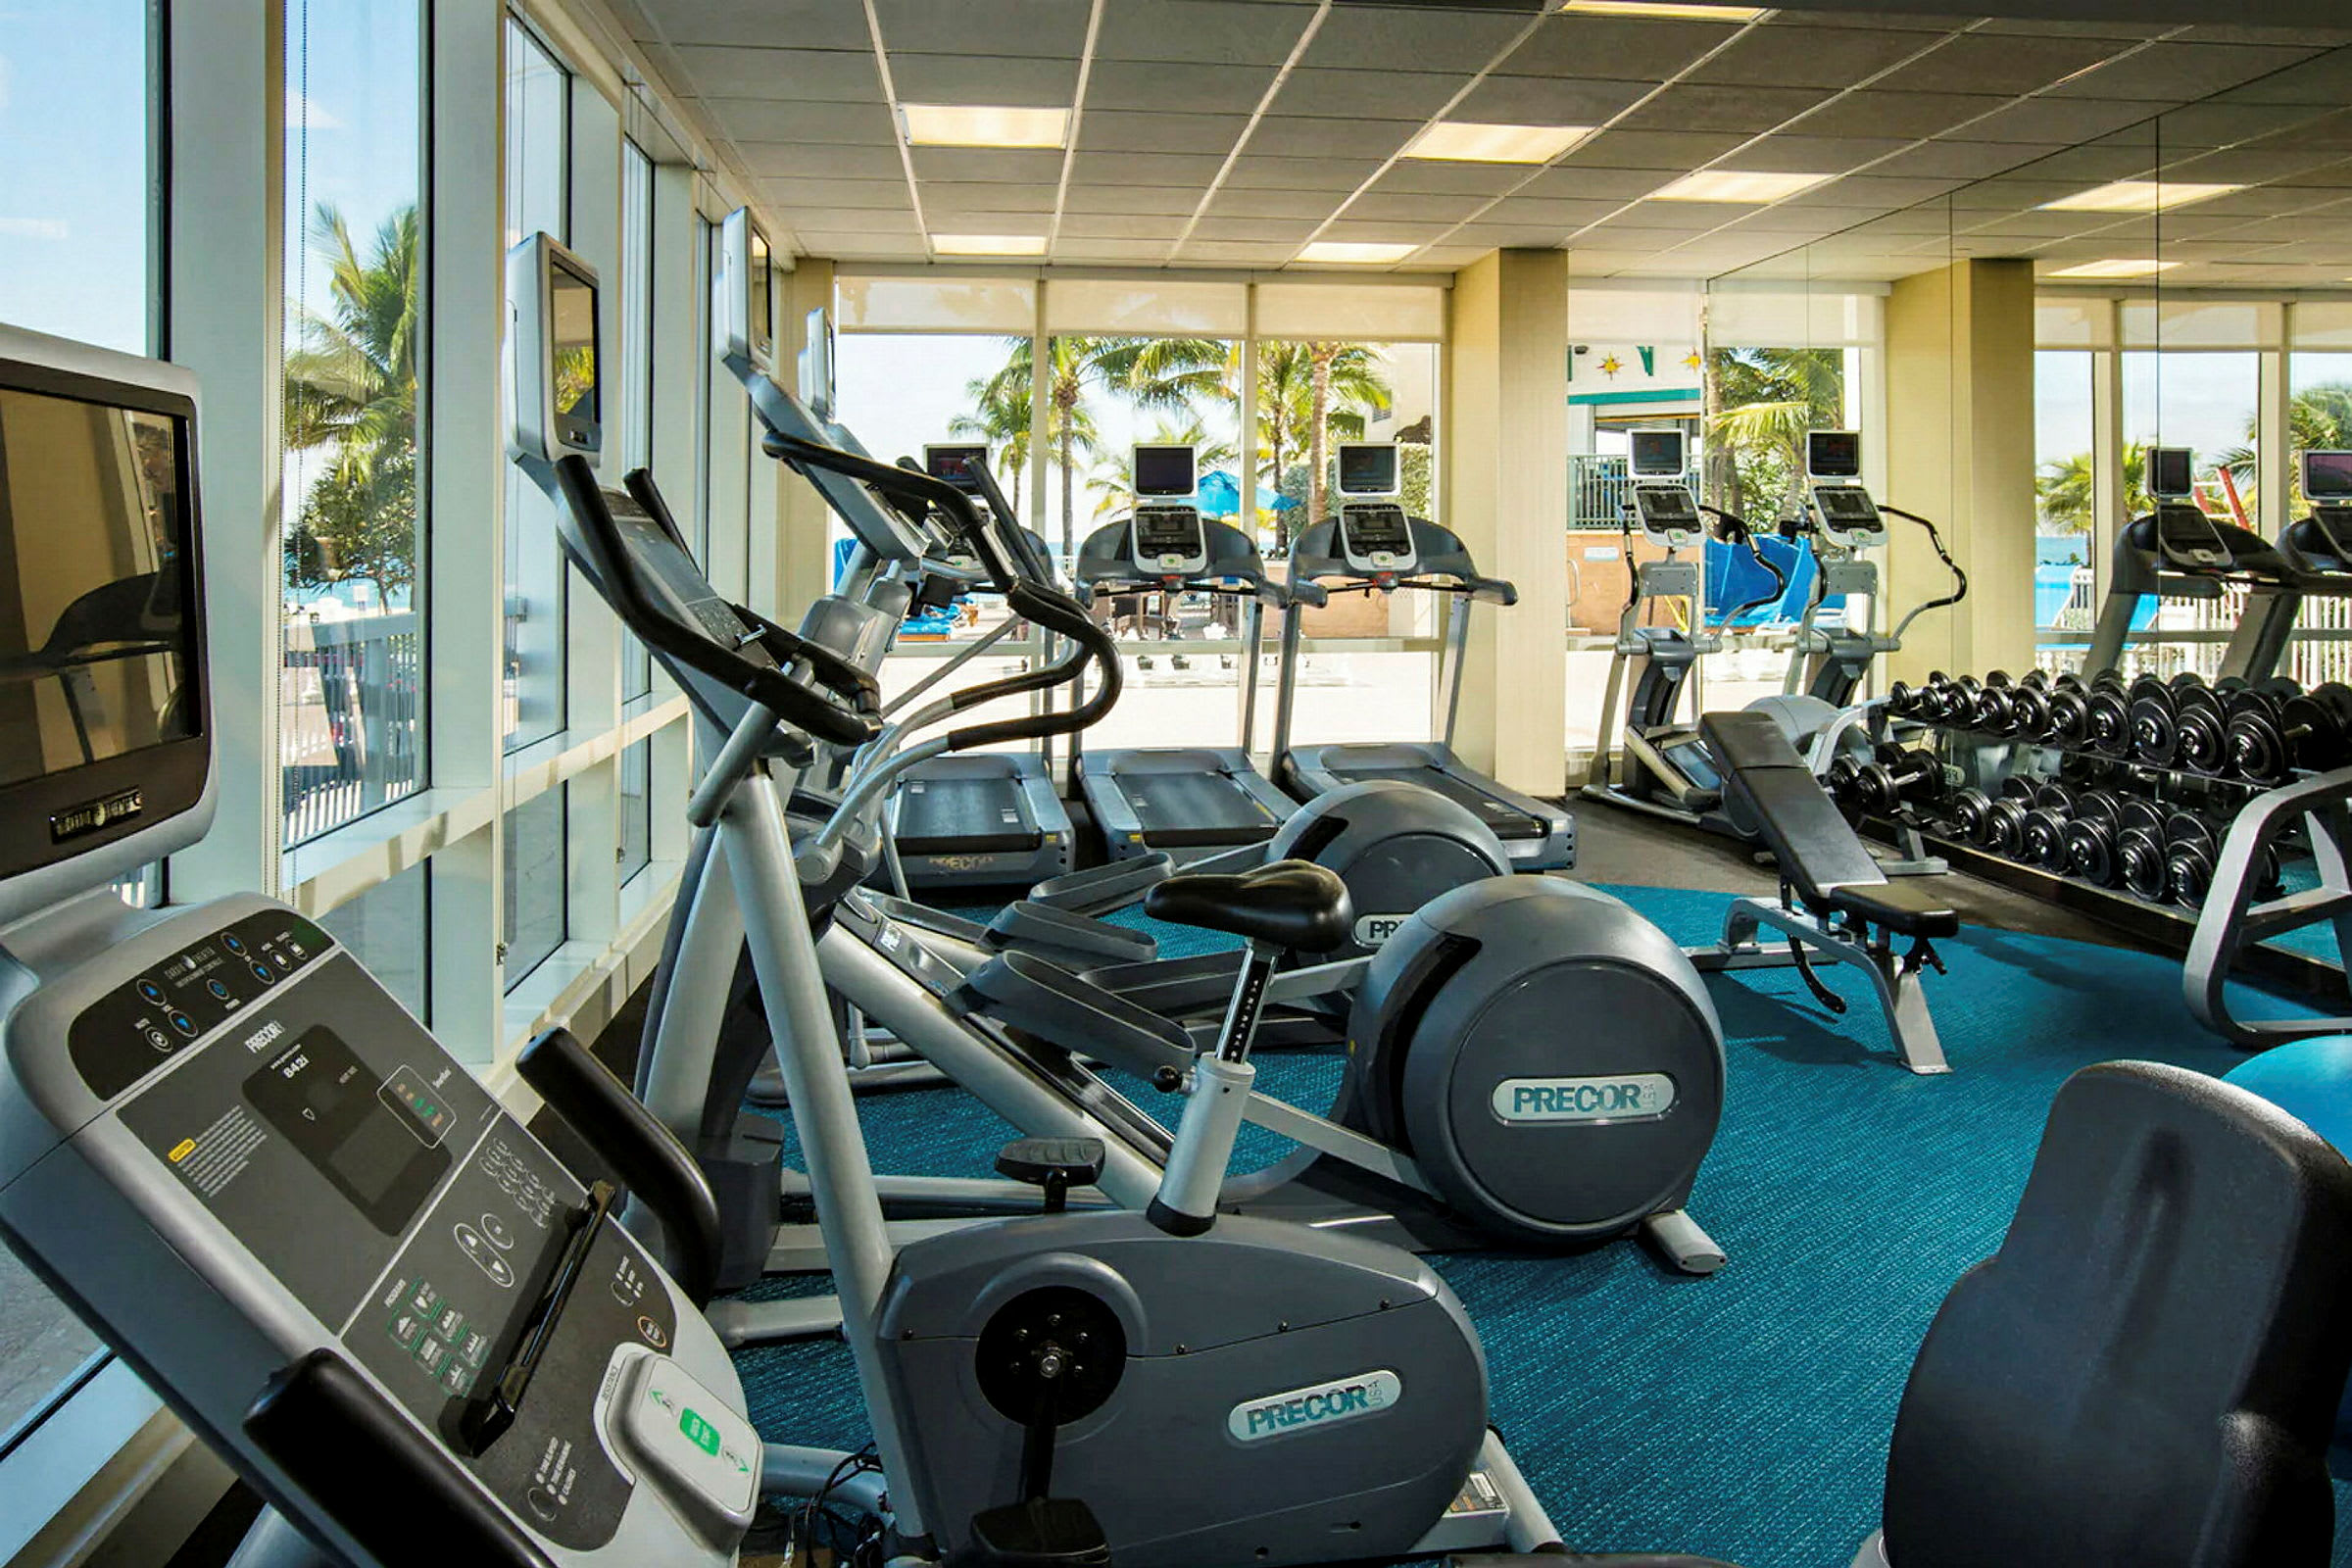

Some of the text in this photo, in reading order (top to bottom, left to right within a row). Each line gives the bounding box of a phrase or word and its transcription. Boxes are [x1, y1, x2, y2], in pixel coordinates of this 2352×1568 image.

[1514, 1084, 1642, 1112] PRECOR
[1246, 1379, 1384, 1435] PRECOR USA
